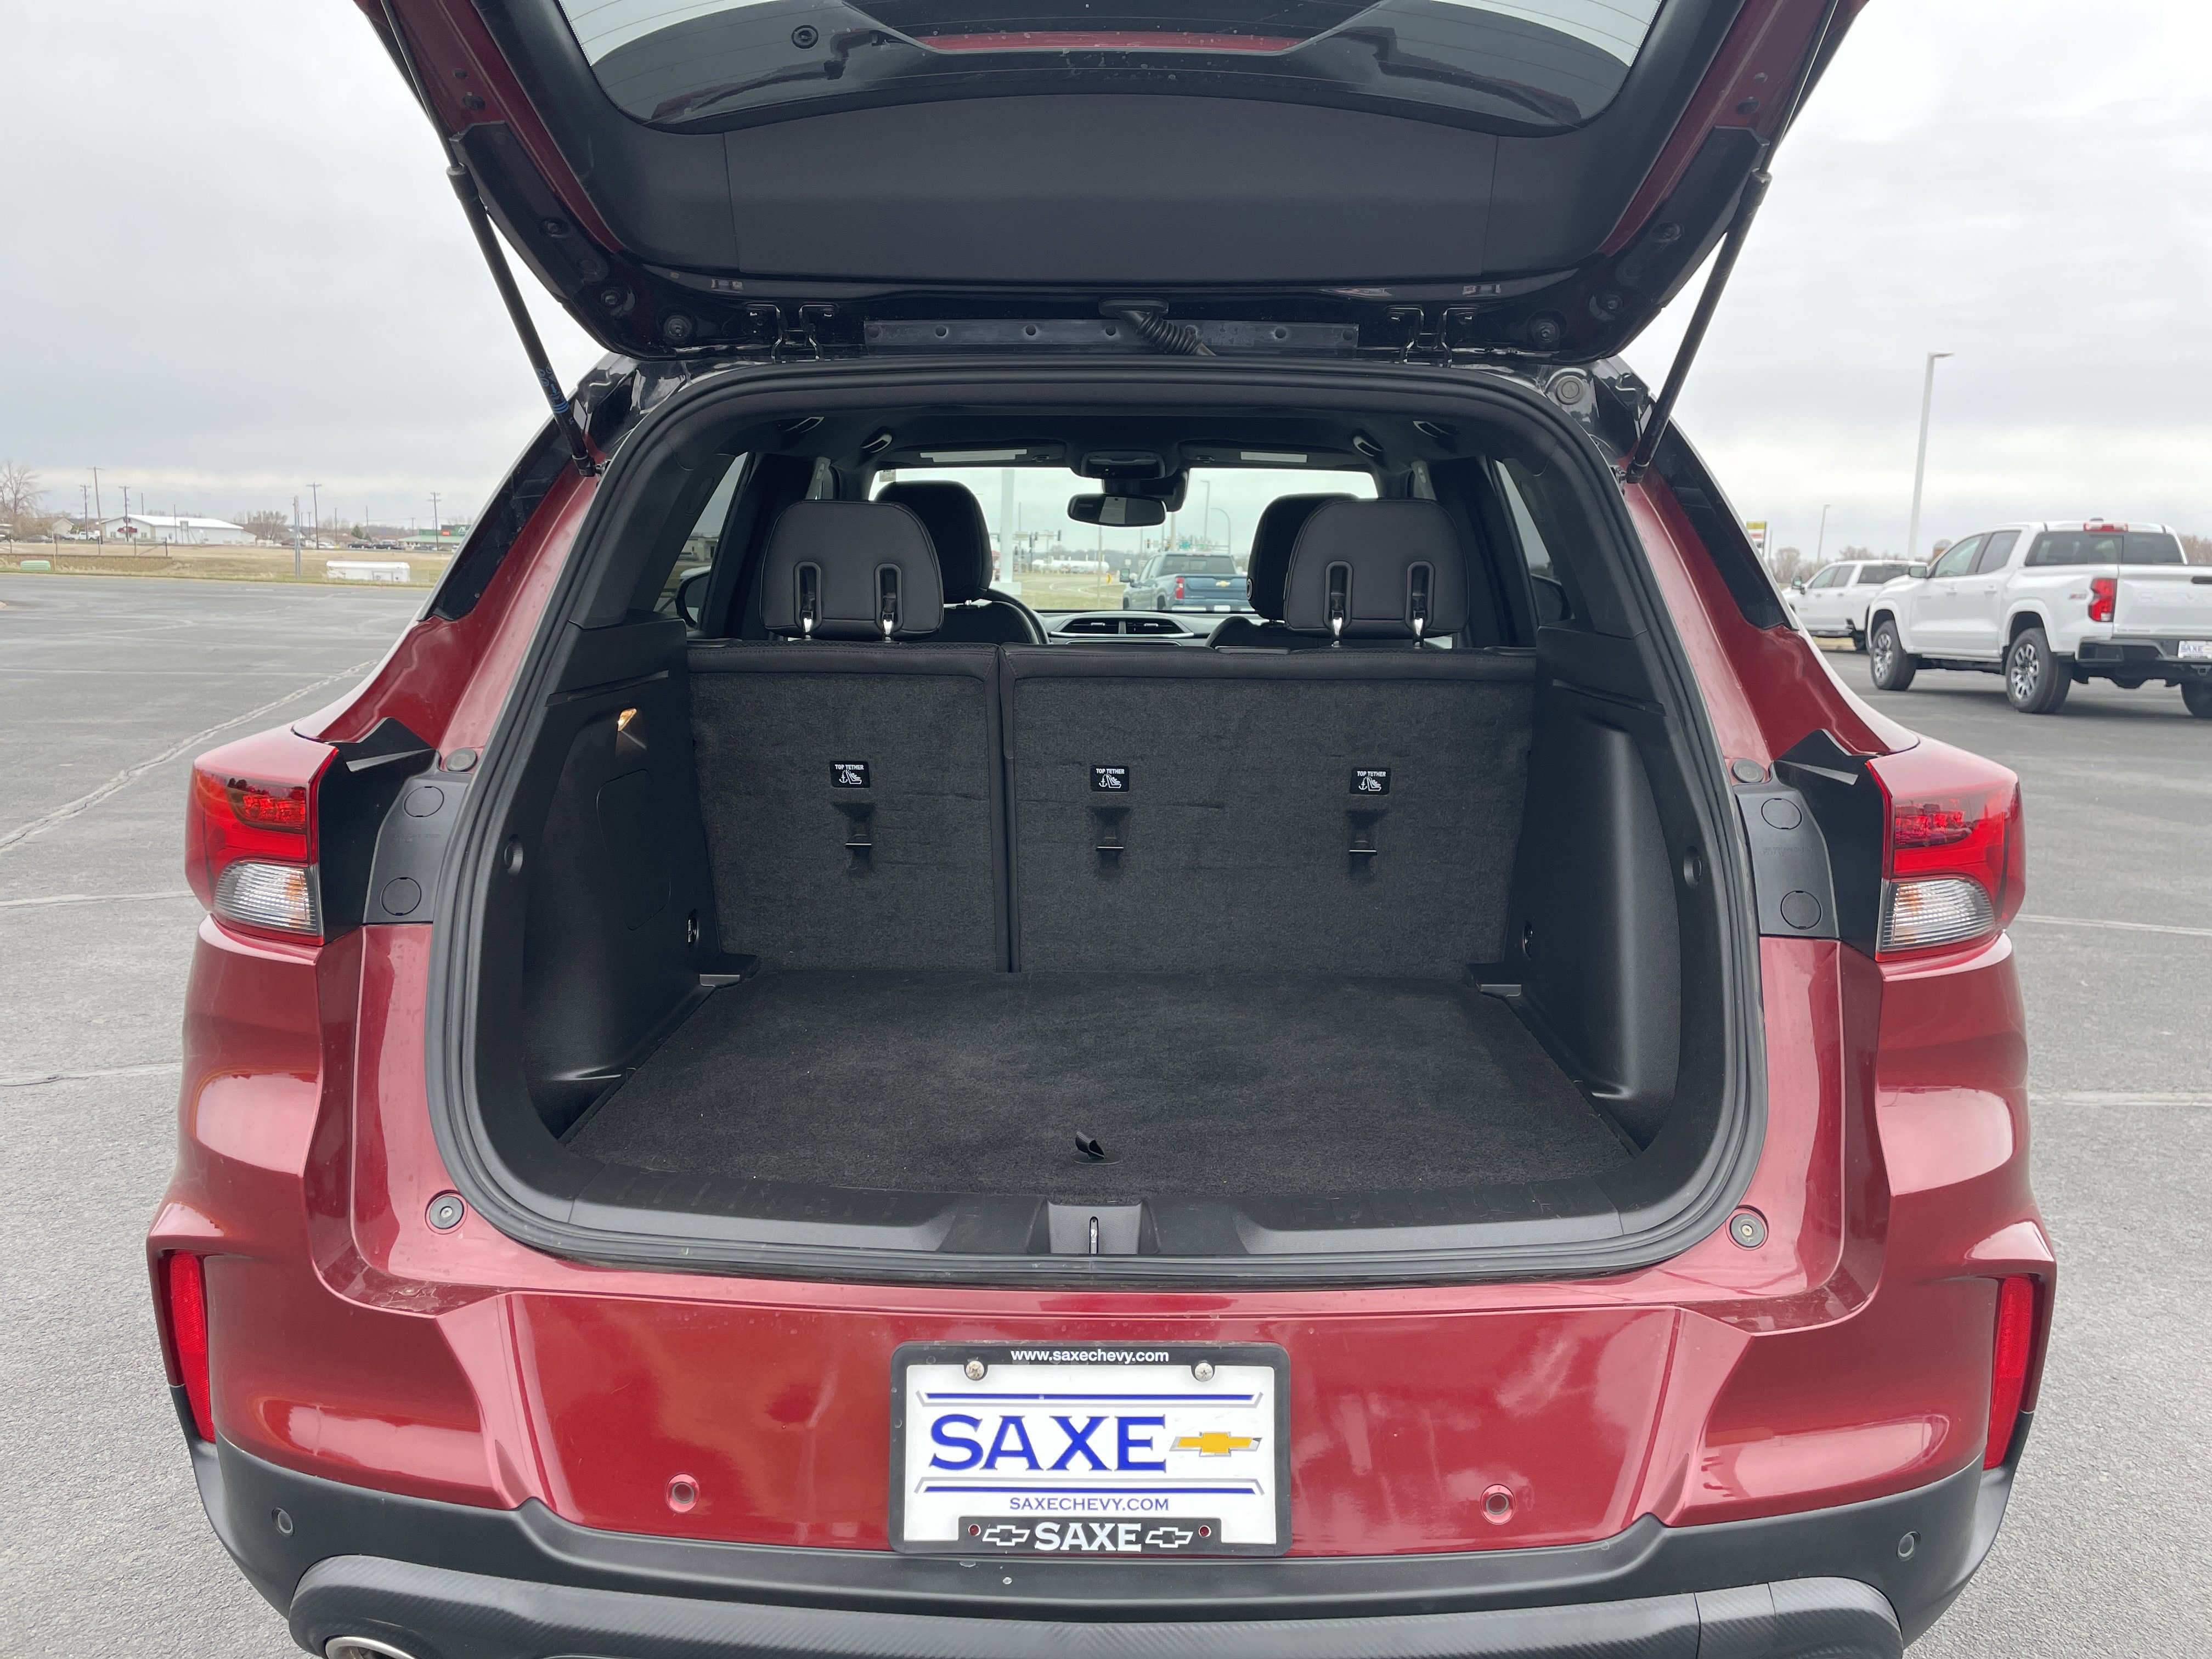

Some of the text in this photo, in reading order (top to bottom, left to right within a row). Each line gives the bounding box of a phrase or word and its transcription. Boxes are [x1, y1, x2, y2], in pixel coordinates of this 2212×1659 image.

[1011, 1349, 1169, 1364] www.saxechevy.com
[928, 1414, 1166, 1473] SAXE
[1009, 1497, 1170, 1511] SAXECHEVY.COM
[1034, 1522, 1142, 1552] SAXE
